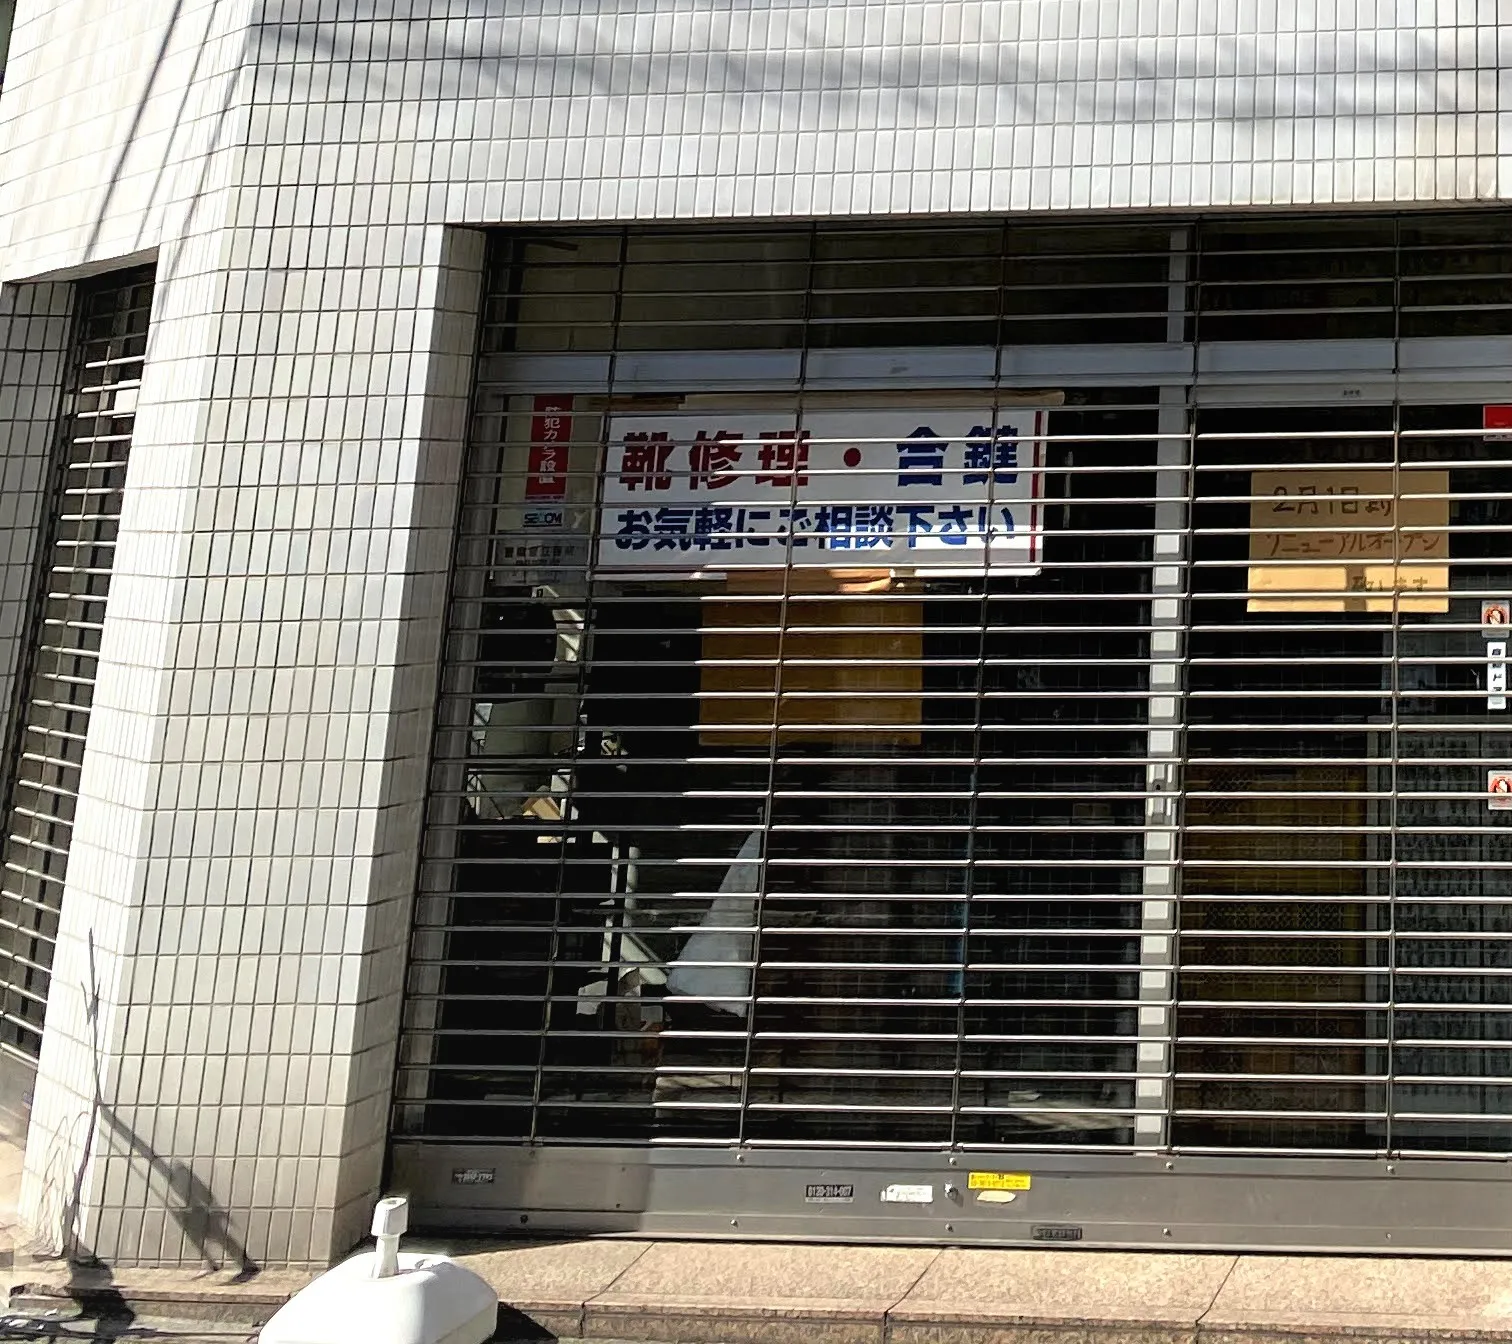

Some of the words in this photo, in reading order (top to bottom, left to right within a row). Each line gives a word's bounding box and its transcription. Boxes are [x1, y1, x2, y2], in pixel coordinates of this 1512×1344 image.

[614, 505, 1016, 552] お気軽にご相談下さい
